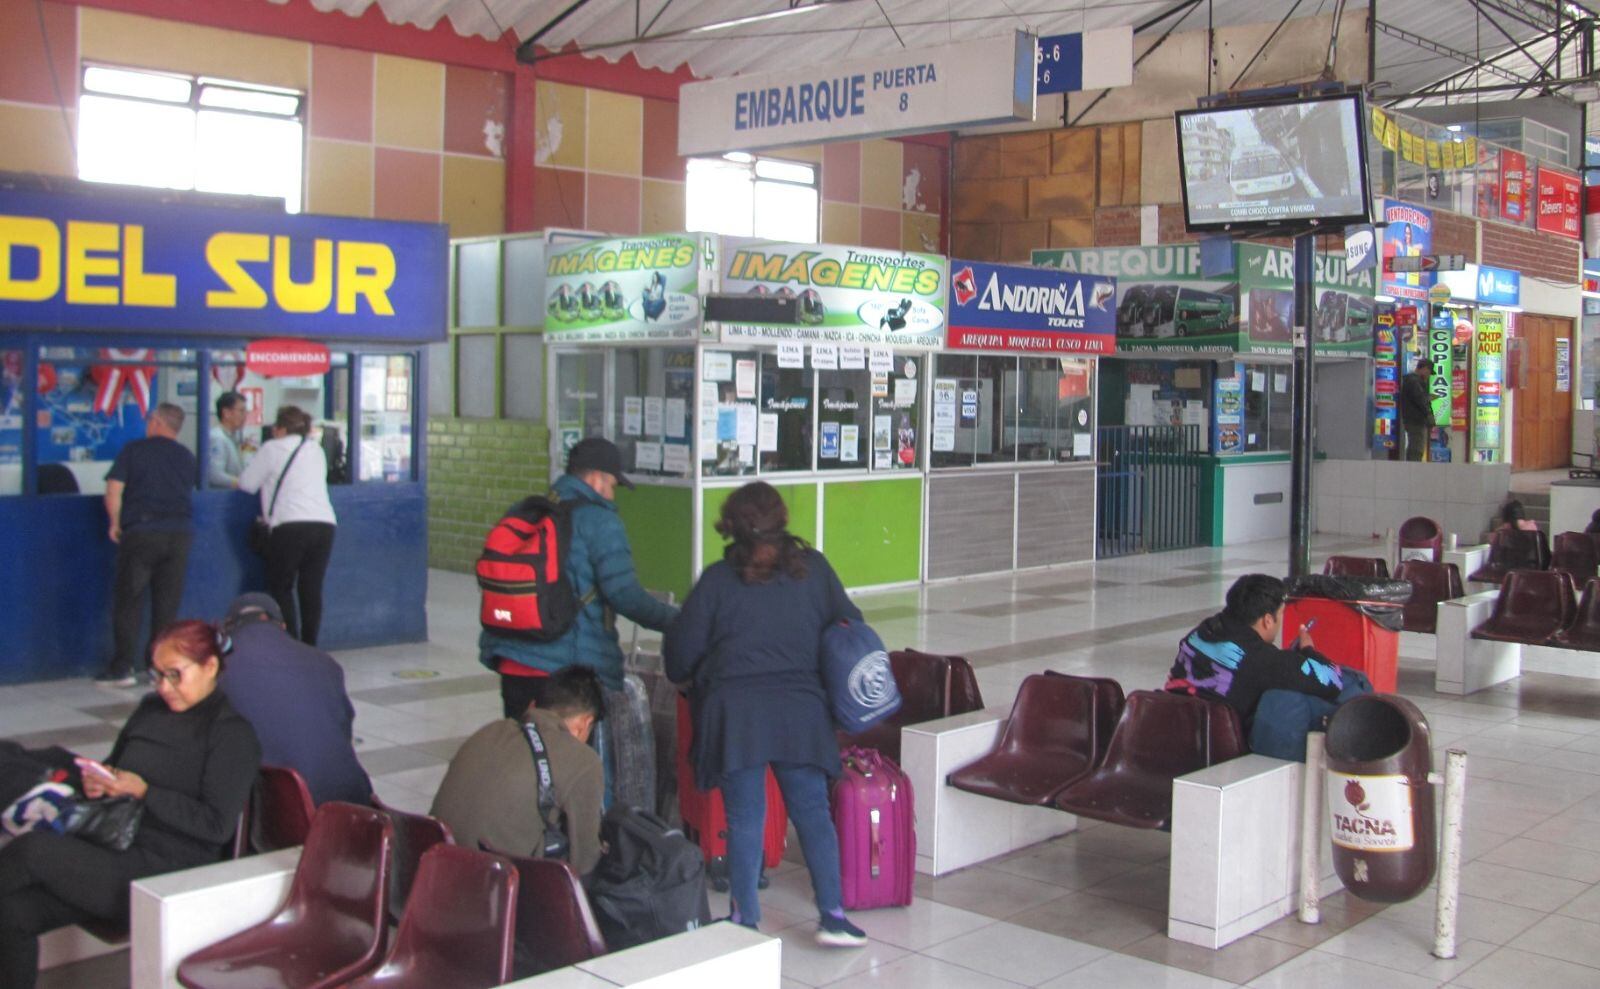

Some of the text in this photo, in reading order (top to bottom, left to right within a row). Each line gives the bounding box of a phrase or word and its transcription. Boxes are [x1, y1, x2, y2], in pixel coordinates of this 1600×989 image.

[1053, 44, 1060, 62] 6
[1043, 69, 1051, 84] 6
[734, 64, 937, 131] EMBARQUE PUERTA
[899, 92, 909, 112] 8
[846, 250, 925, 268] Transportes
[1346, 241, 1368, 259] SUNG
[0, 215, 397, 316] DEL SUR
[547, 246, 695, 276] IMÁGENES
[726, 251, 940, 295] IMÁGENES
[978, 271, 1085, 316] ANDORIÑA
[1048, 317, 1085, 328] TOURS
[728, 325, 743, 336] LIMA
[748, 326, 757, 336] ILO
[761, 327, 792, 339] MOLLENDO
[824, 330, 841, 341] NAZCA
[846, 332, 854, 341] ICA
[858, 332, 881, 343] CHINCHA
[885, 334, 913, 345] MOQUEGUA
[916, 336, 939, 347] AREQUIPA
[960, 334, 1003, 349] AREQUIPA
[1007, 336, 1051, 349] MOQUEGUA
[1056, 338, 1081, 350] CUSCO
[1084, 340, 1103, 351] LIMA
[1478, 331, 1502, 342] CHIP
[250, 352, 327, 363] ENCOMIENDAS
[816, 347, 832, 355] LIMA
[1478, 343, 1502, 355] AQUI
[1432, 331, 1449, 398] COPIAS
[1334, 813, 1397, 836] TACNA
